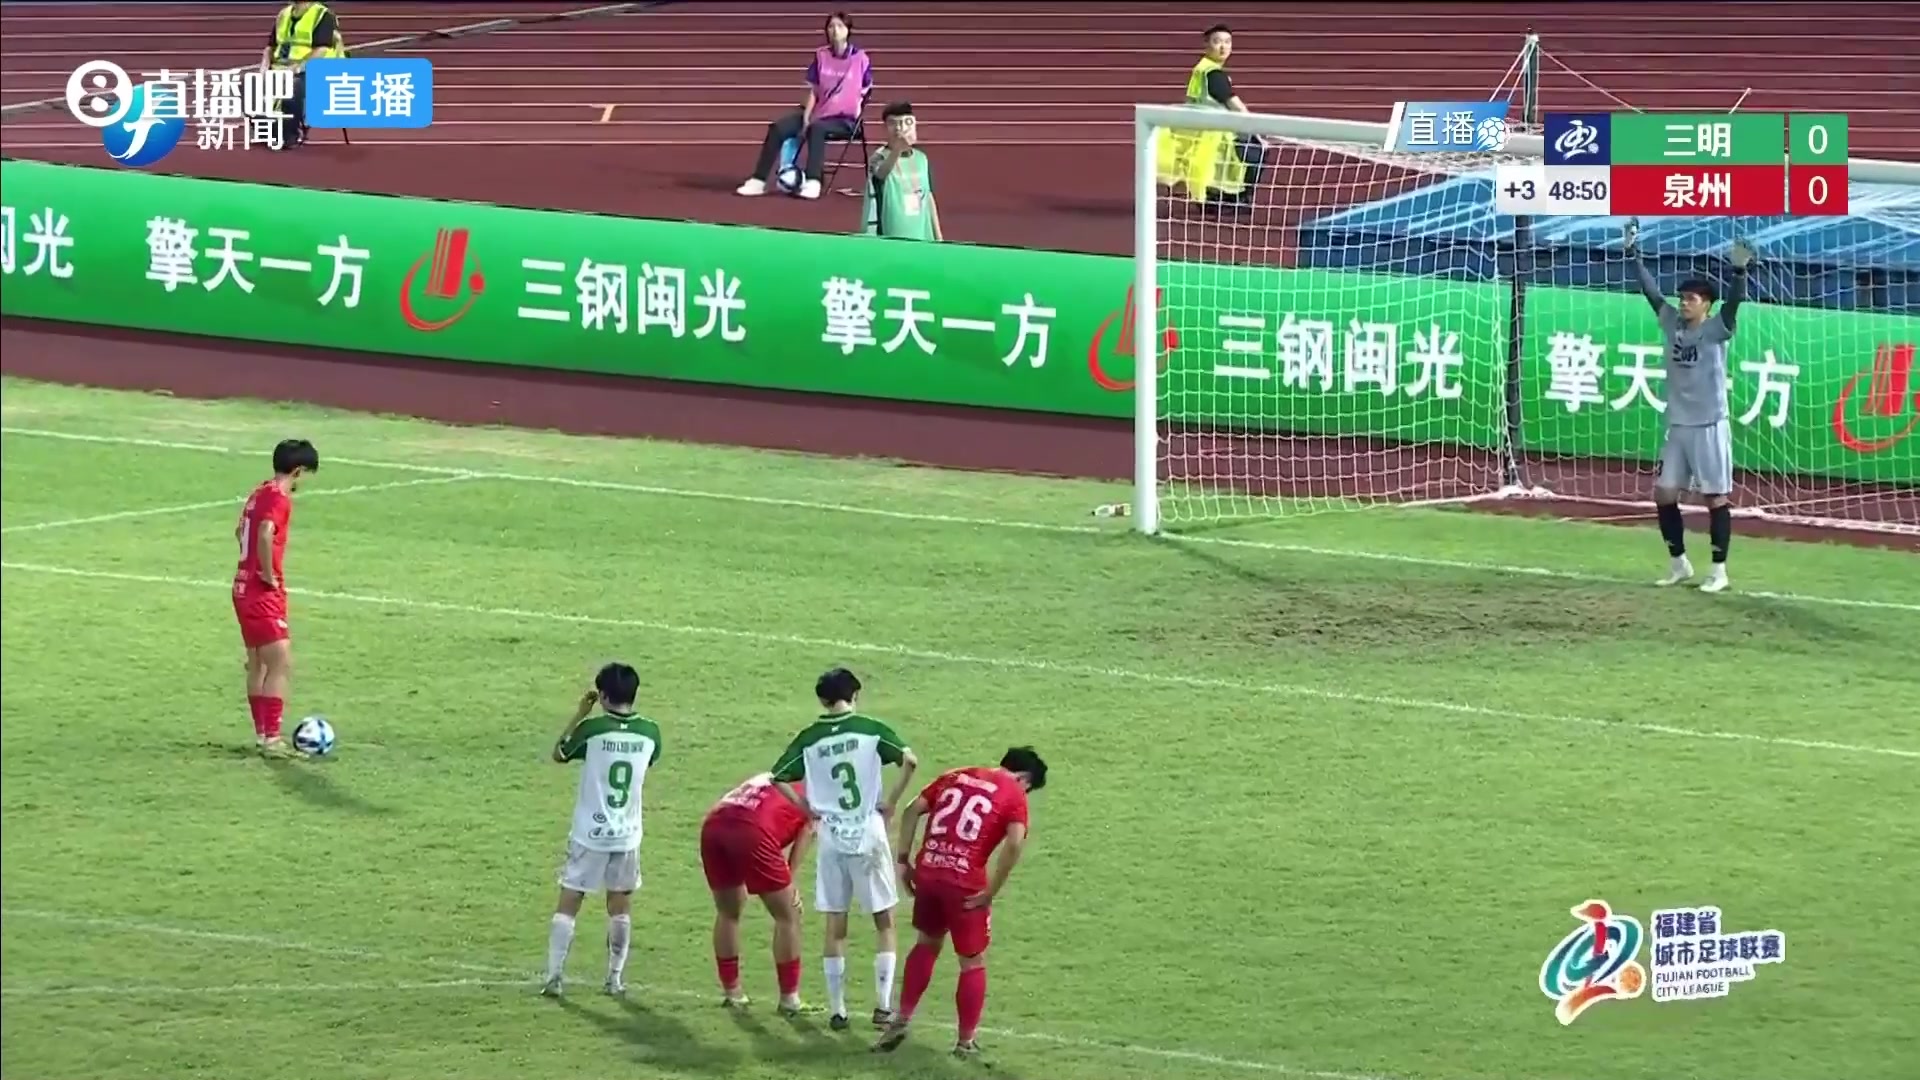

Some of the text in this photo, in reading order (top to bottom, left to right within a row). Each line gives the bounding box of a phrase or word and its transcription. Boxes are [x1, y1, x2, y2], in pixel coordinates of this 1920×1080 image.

[145, 215, 371, 308] 擎天一方
[517, 257, 1057, 369] 三钢闽光 擎天一方
[1213, 312, 1801, 428] 三钢闽光 擎天方
[607, 760, 633, 809] 9
[831, 762, 862, 811] 3
[931, 787, 993, 841] 26
